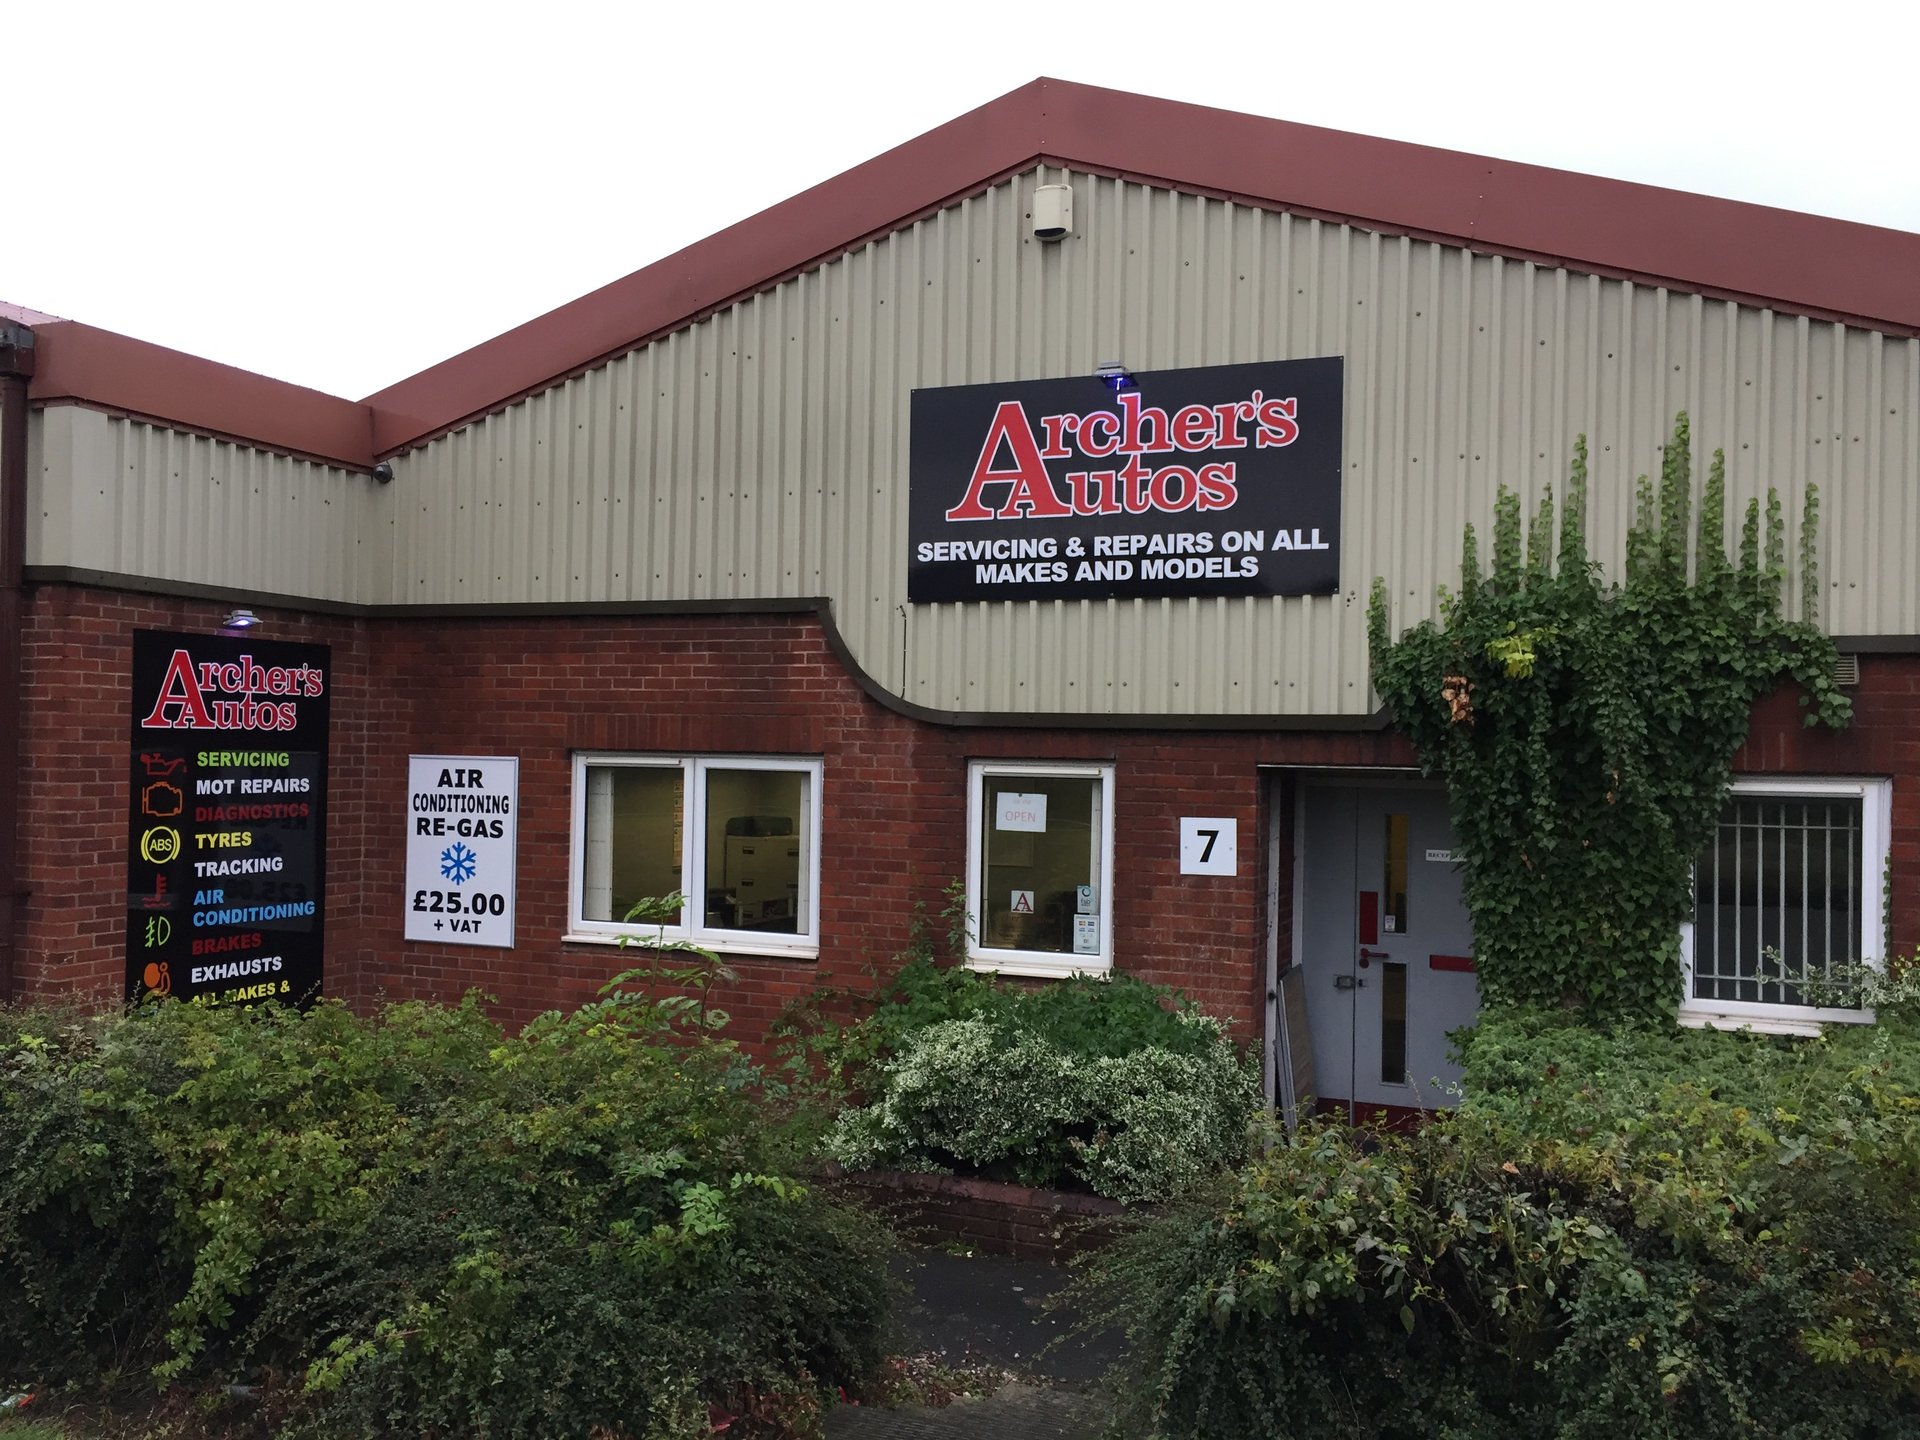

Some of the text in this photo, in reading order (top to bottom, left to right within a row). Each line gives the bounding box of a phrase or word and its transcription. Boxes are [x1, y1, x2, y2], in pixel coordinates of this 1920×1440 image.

[946, 390, 1299, 522] Archer's
[997, 452, 1238, 521] Autos
[918, 529, 1329, 562] SERVICING & REPAIRS ON ALL
[976, 556, 1259, 584] MAKES AND MODELS
[142, 649, 323, 729] Archer's
[173, 692, 297, 730] Autos
[197, 752, 290, 767] SERVICING
[196, 778, 310, 795] MOT REPAIRS
[437, 769, 484, 788] AIR
[195, 803, 310, 822] DIAGNOSTICS
[413, 793, 510, 814] CONDITIONING
[1005, 811, 1036, 822] OPEN
[416, 817, 504, 839] RE-GAS
[150, 838, 172, 851] ABS
[195, 832, 252, 849] TYRES
[1197, 830, 1219, 862] 7
[194, 857, 283, 877] TRACKING
[193, 889, 224, 905] AIR
[413, 890, 505, 916] £25.00
[193, 901, 315, 927] CONDITIONING
[434, 919, 482, 933] + VAT
[192, 933, 262, 955] BRAKES
[191, 956, 282, 983] EXHAUSTS
[280, 980, 290, 993] &
